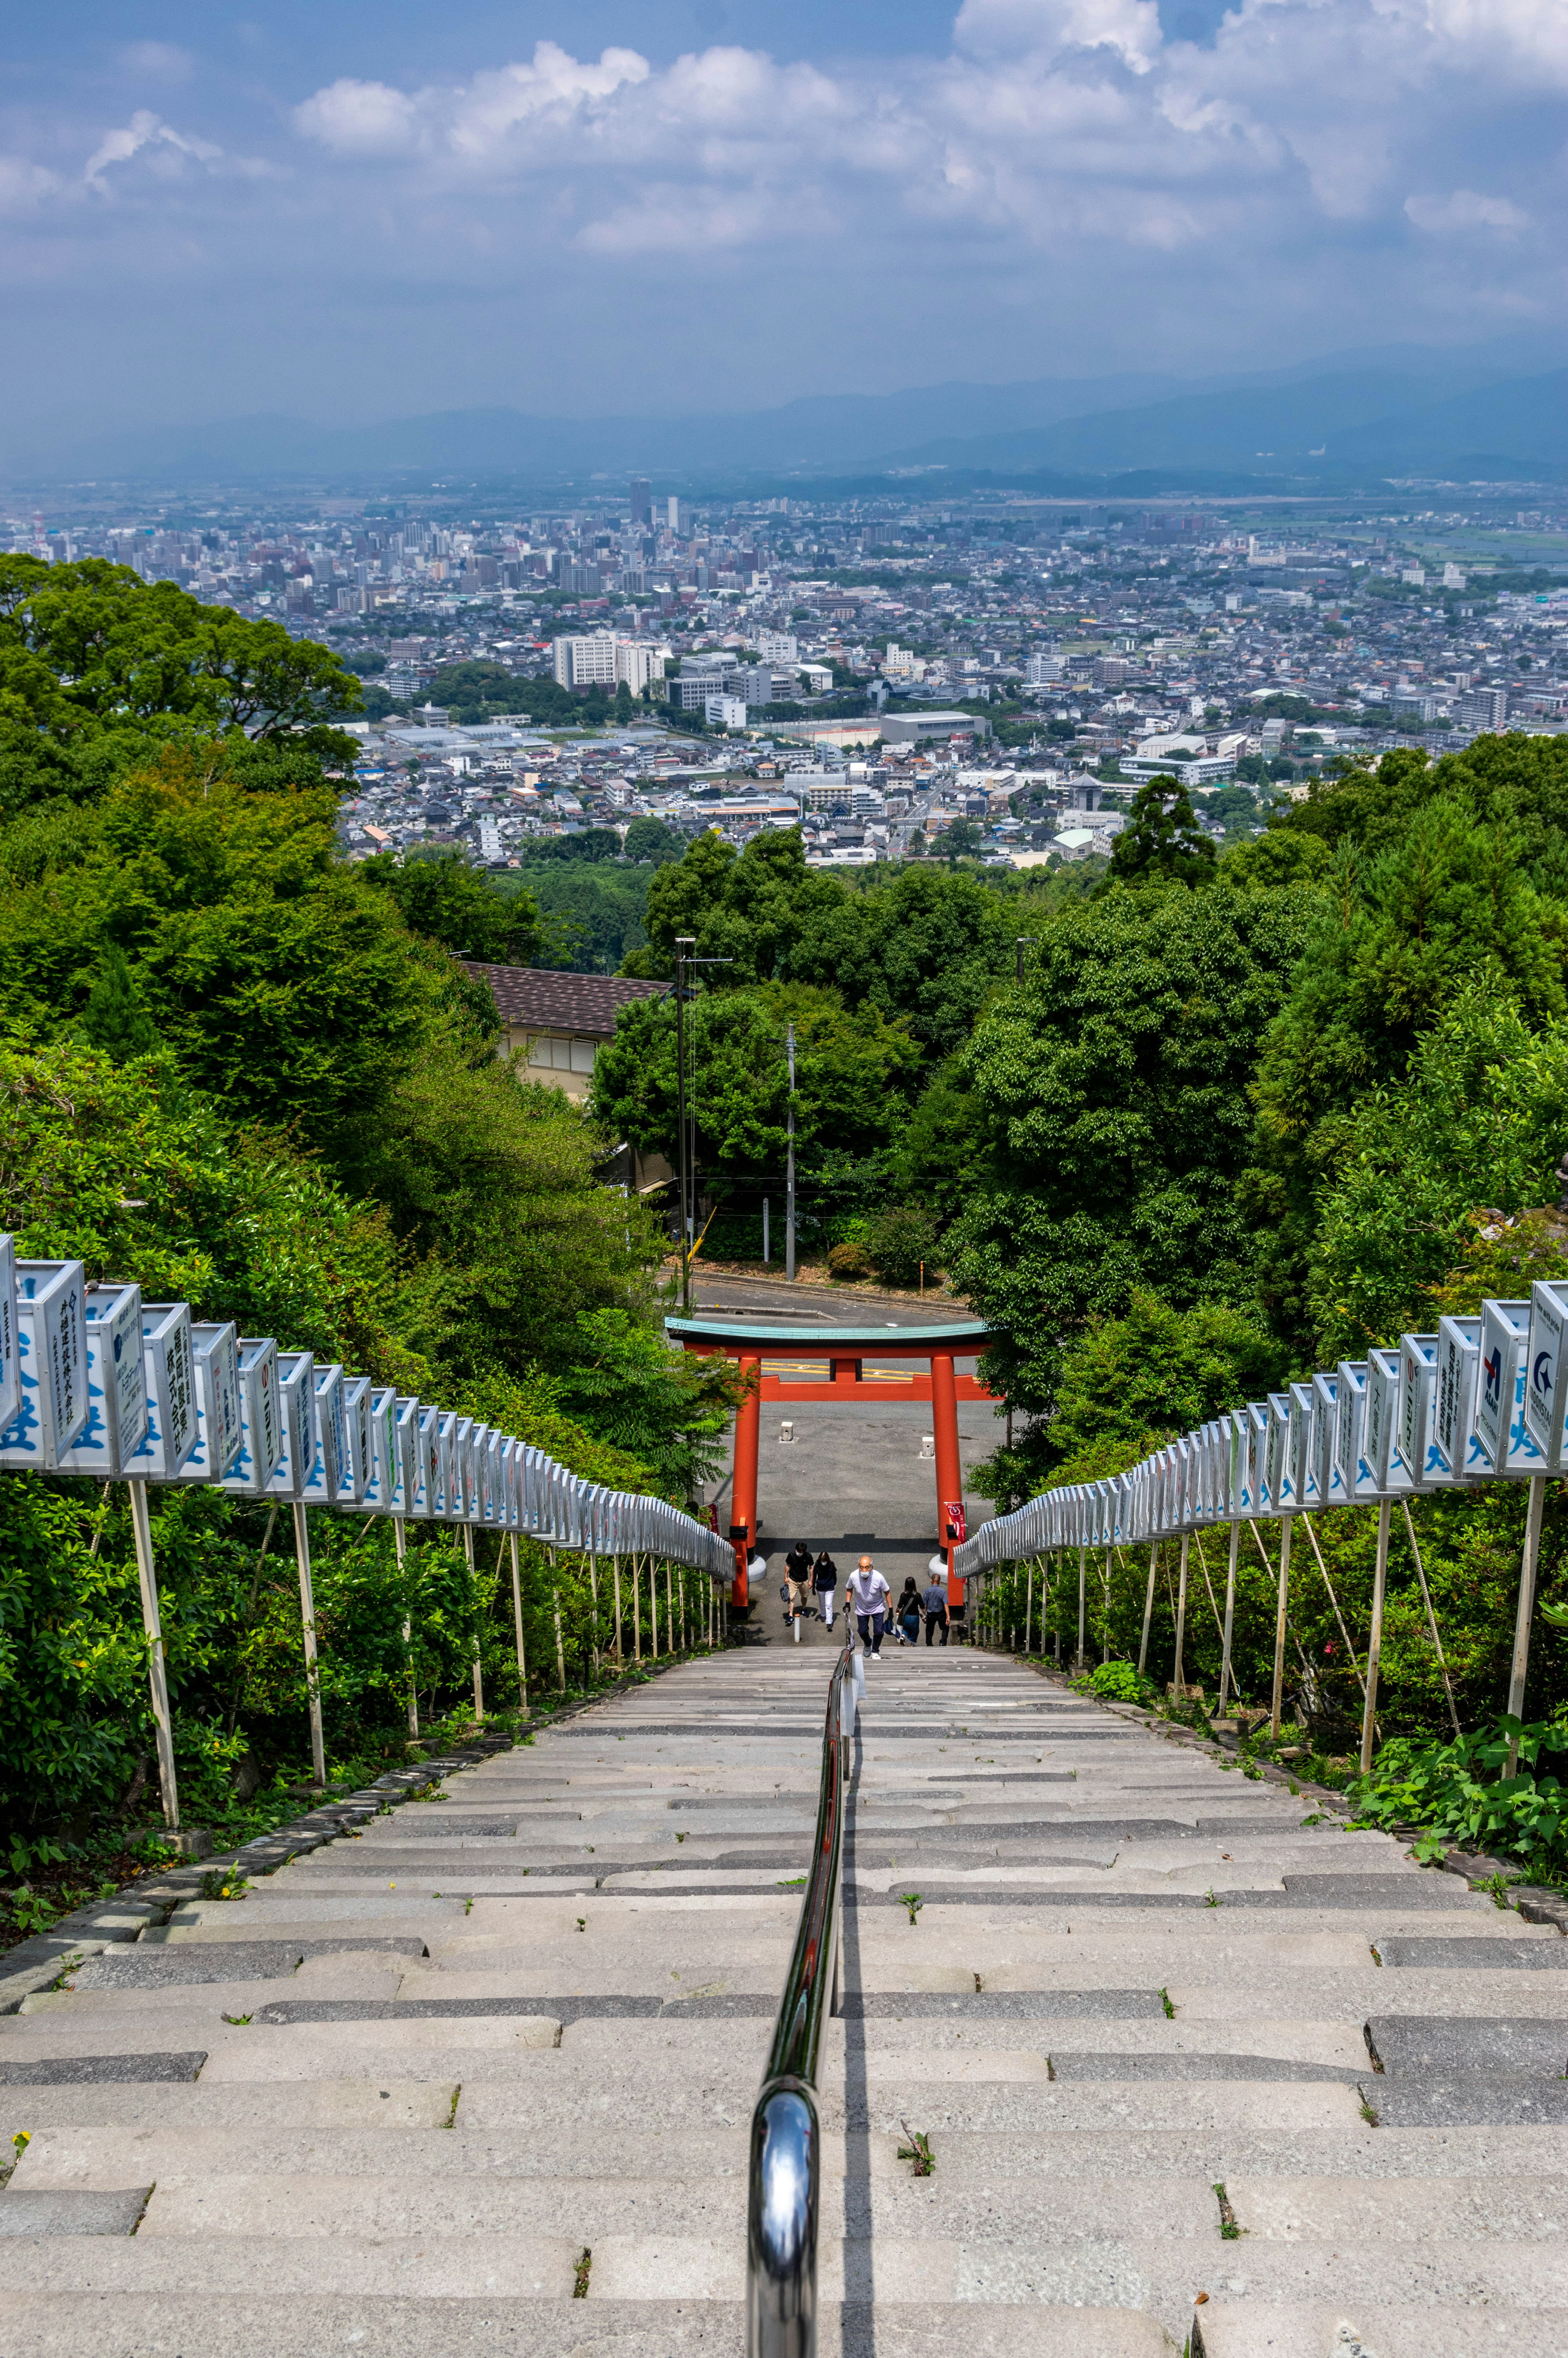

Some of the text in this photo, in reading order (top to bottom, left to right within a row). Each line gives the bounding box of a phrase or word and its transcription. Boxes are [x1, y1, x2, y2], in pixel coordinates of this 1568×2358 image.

[1550, 1318, 1560, 1335] pride.
[167, 1347, 182, 1456] 株式会社
[174, 1327, 187, 1438] 福岡酸素
[227, 1340, 236, 1426] フジクリーン
[1439, 1365, 1447, 1441] 株式会社
[1485, 1389, 1498, 1417] ASAHI
